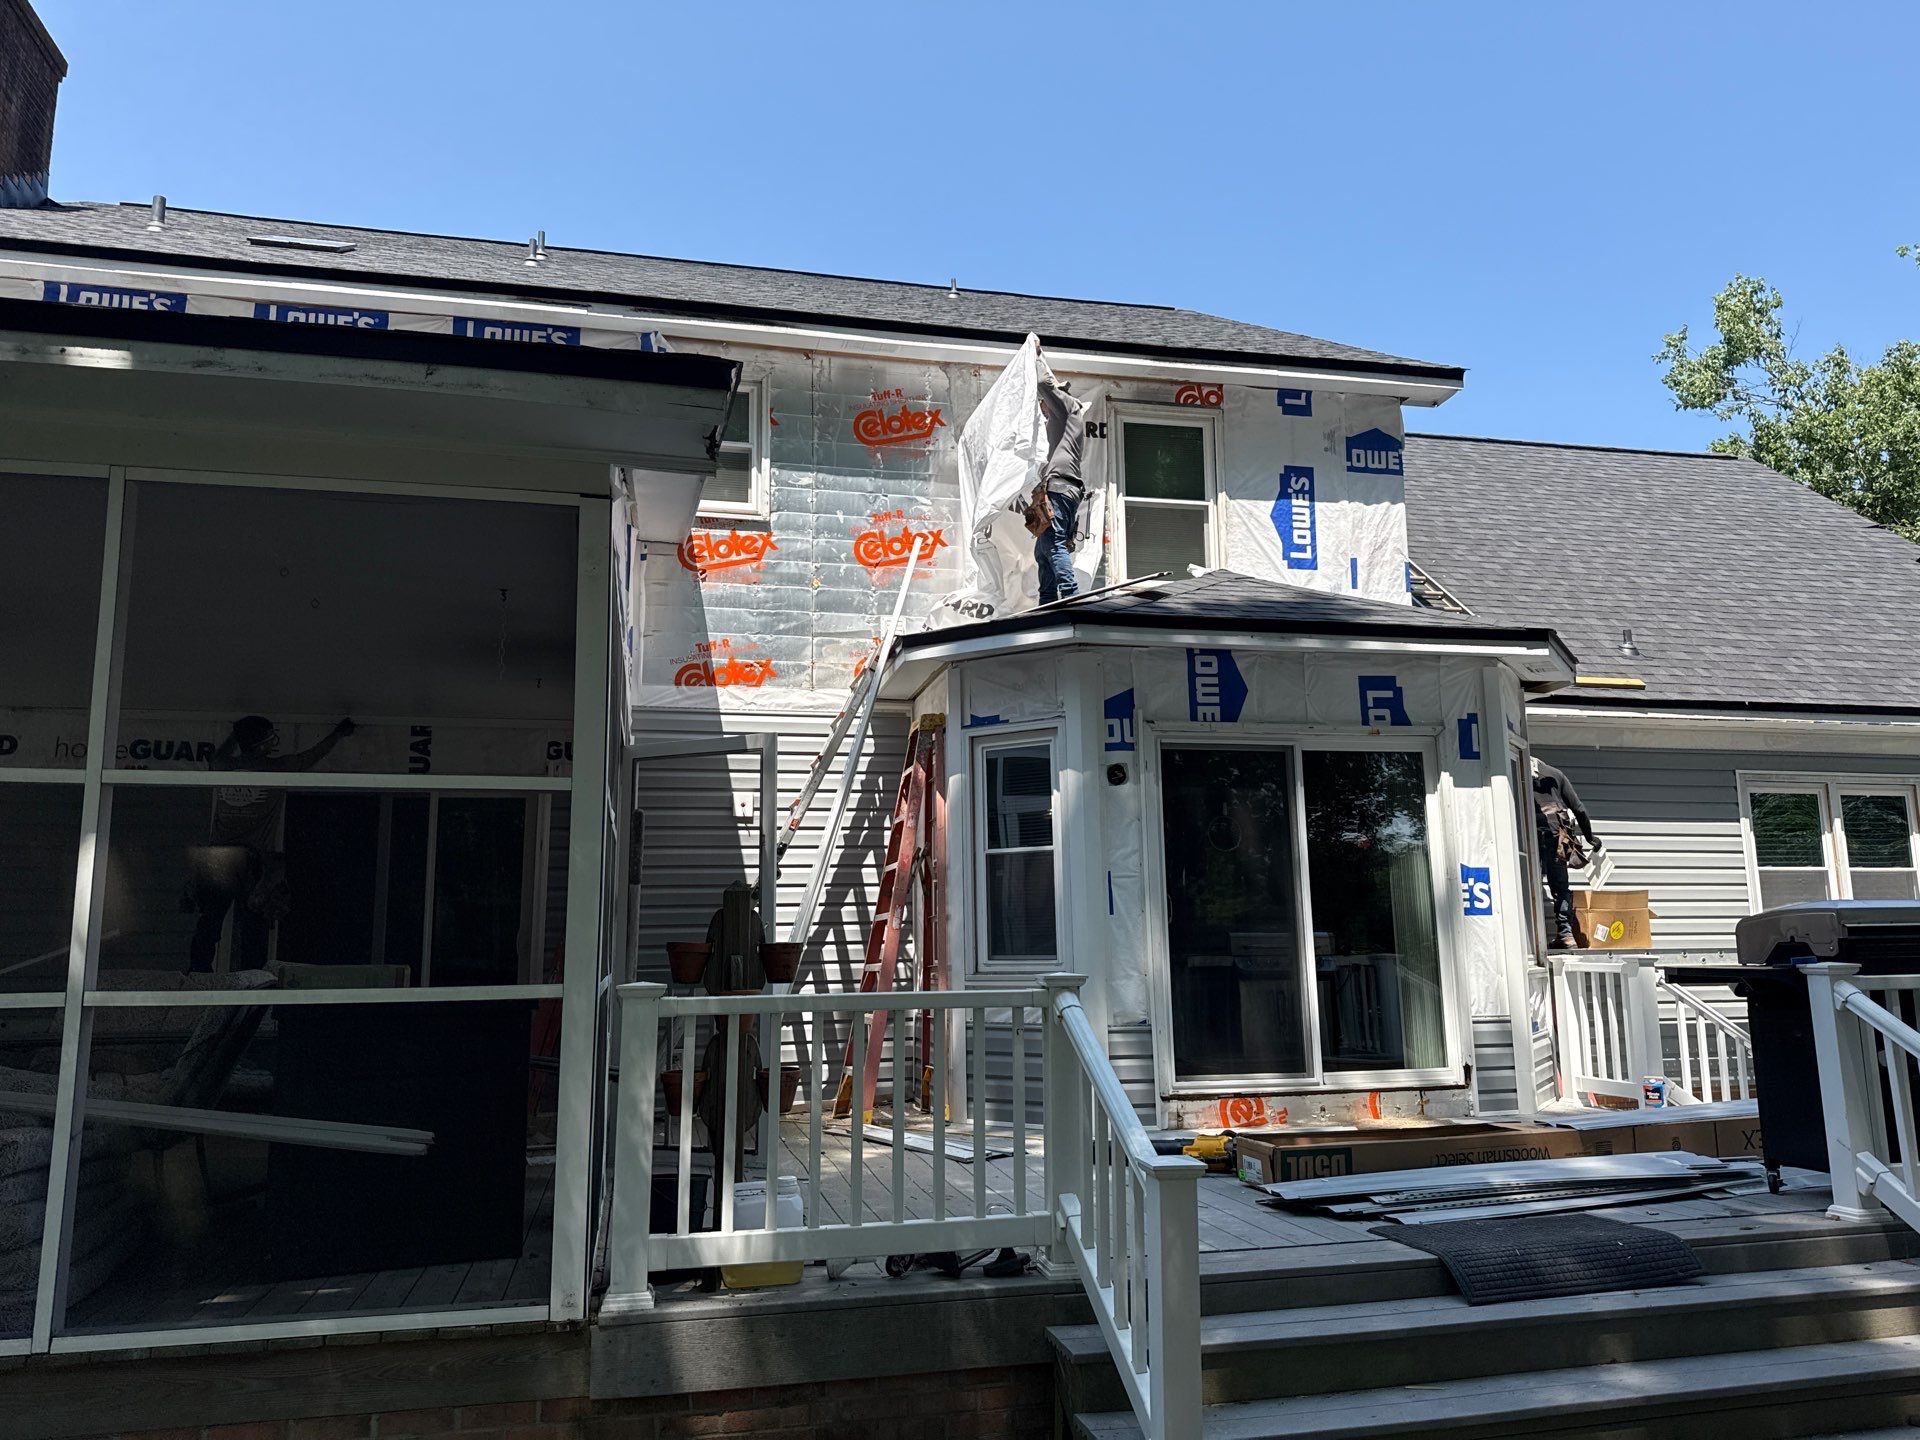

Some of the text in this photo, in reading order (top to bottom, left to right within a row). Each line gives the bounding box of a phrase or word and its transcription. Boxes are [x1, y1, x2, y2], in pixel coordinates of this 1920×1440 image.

[853, 404, 946, 447] Celotex
[1346, 448, 1400, 470] OWE
[1288, 476, 1312, 559] LOWE'S
[677, 527, 779, 572] Celotex
[853, 525, 949, 568] Celotex
[1194, 649, 1221, 722] OWE
